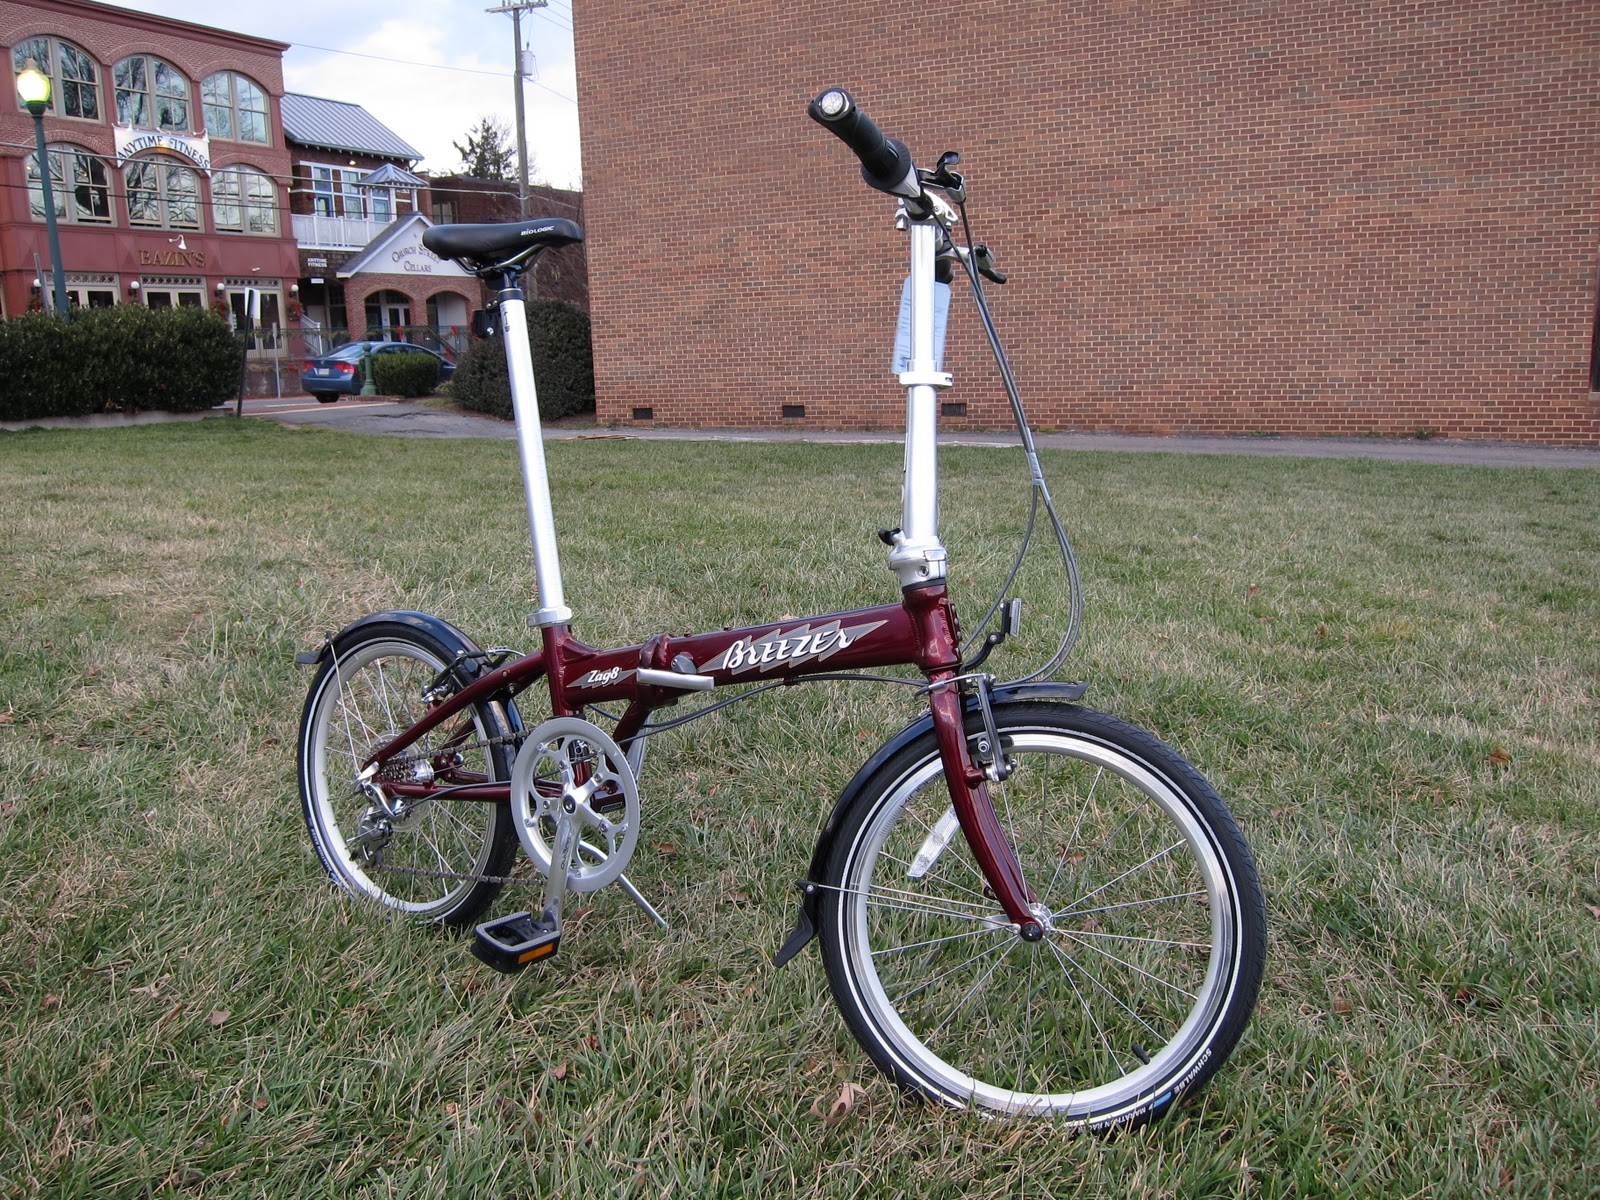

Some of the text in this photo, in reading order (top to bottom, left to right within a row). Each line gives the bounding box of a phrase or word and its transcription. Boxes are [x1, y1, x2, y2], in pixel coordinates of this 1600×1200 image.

[117, 135, 210, 168] ANYTIME FITNESS
[139, 250, 205, 268] BAZIN'S
[392, 246, 417, 262] CHURCH
[404, 260, 432, 273] CELLARS
[587, 666, 620, 685] Zag8
[1173, 1047, 1212, 1095] SCHWALBE
